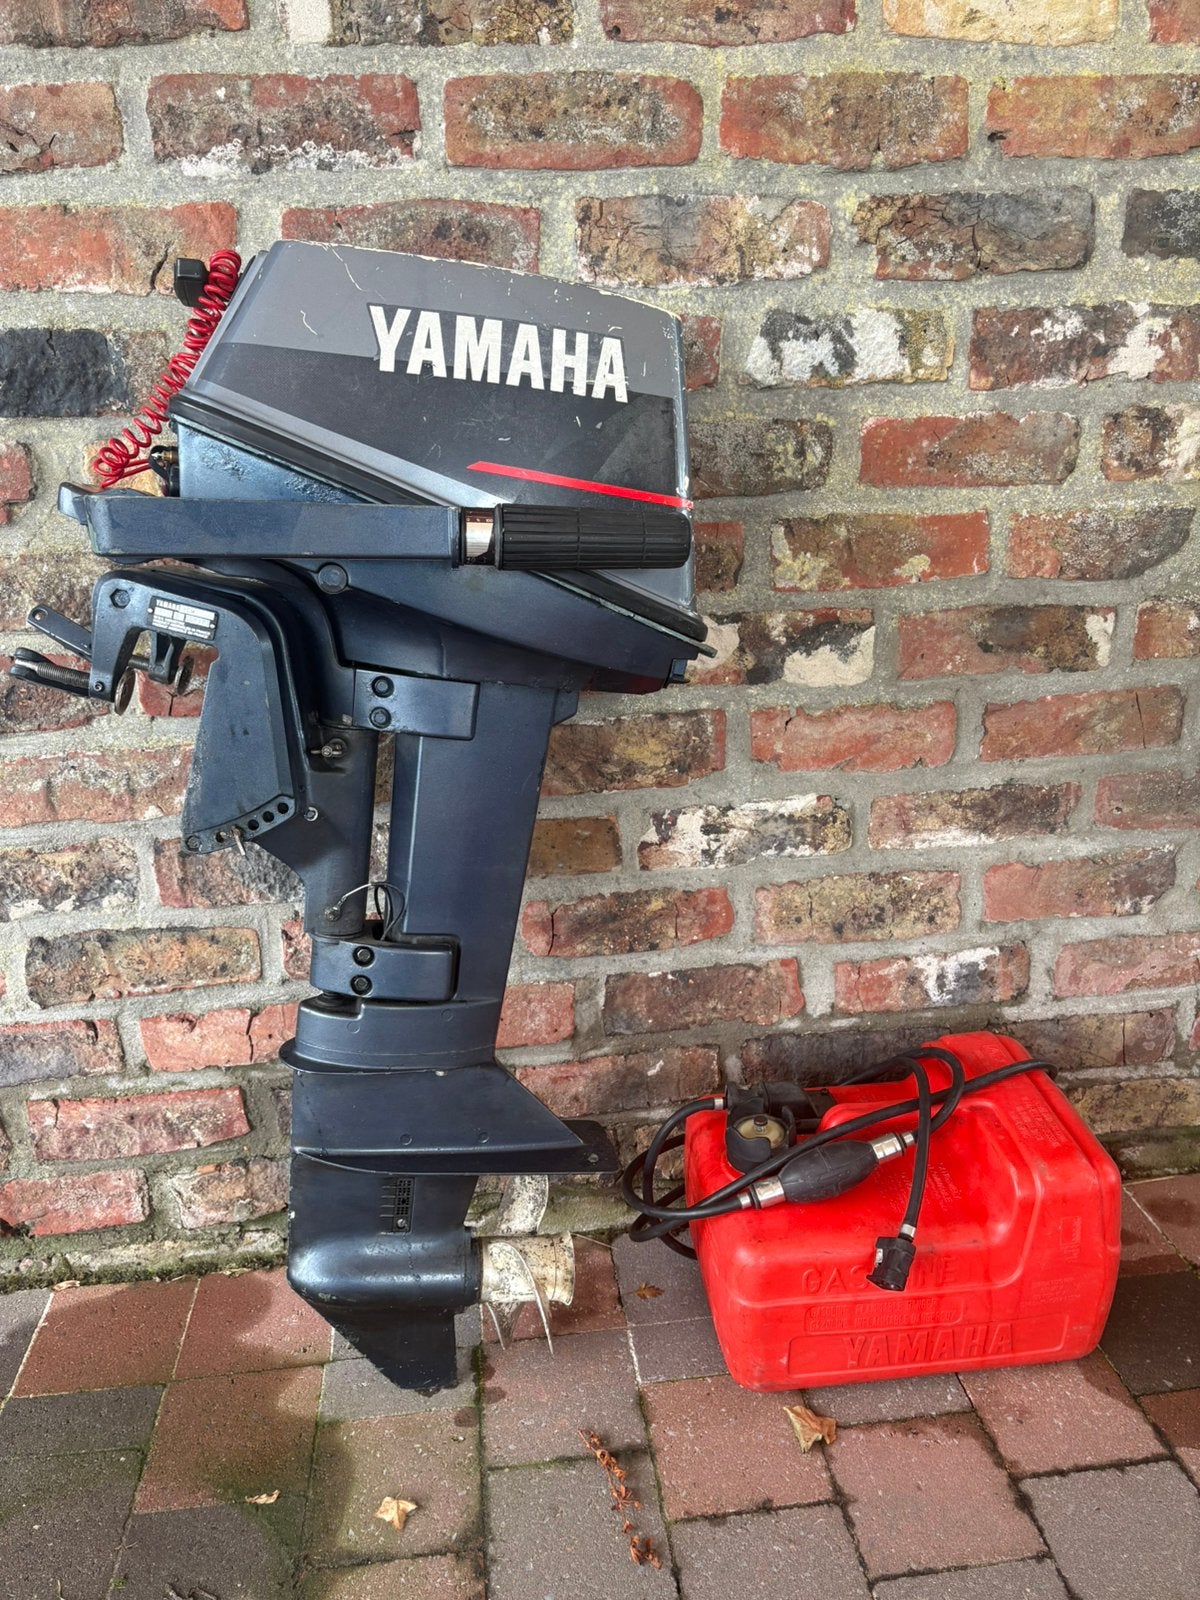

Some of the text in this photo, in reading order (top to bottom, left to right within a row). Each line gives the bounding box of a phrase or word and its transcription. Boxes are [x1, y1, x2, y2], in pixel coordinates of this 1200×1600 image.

[369, 304, 629, 404] YAMAHA
[801, 1256, 958, 1295] GASINE
[842, 1322, 1014, 1369] YAMAHA
